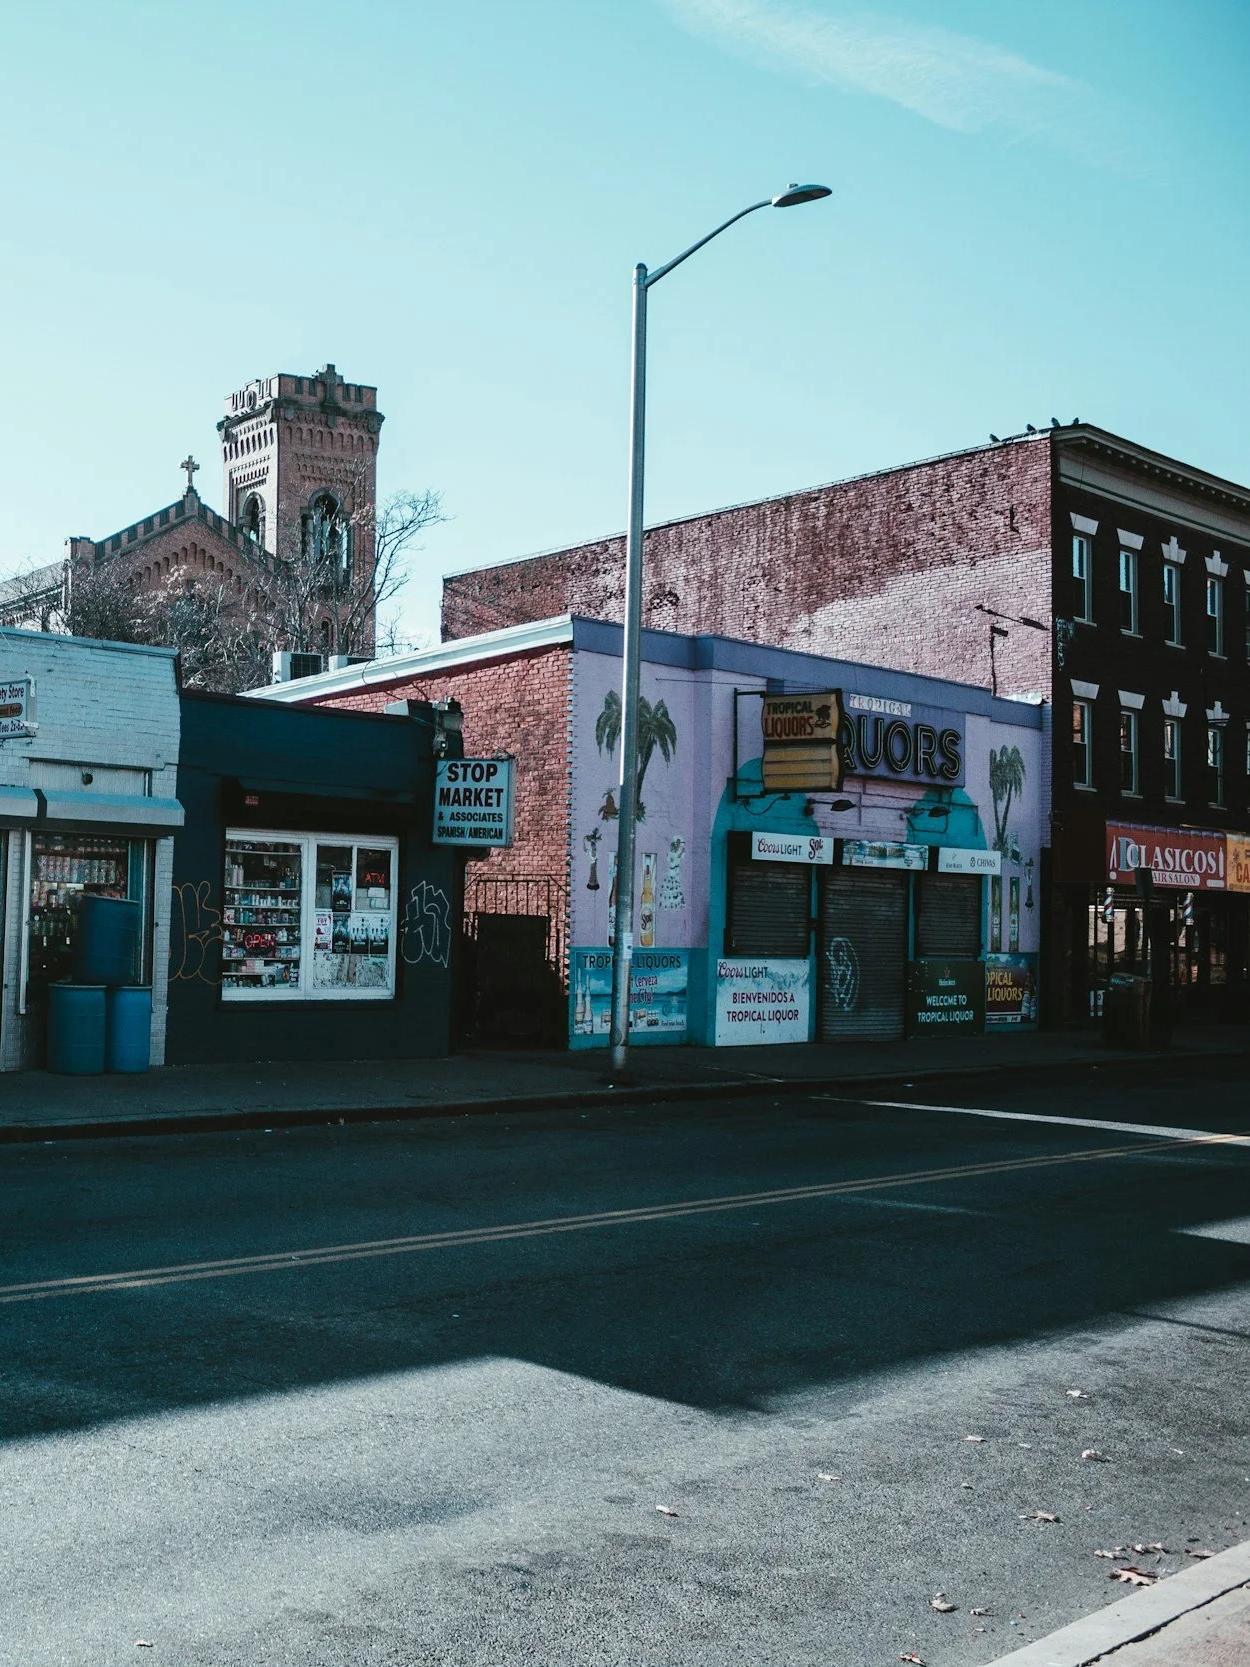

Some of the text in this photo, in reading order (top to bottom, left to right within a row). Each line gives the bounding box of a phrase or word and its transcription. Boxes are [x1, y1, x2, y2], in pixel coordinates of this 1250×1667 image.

[9, 684, 24, 698] Store
[766, 700, 813, 715] TROPICAL
[764, 716, 814, 738] LIQUORS
[842, 712, 962, 780] QUORS
[447, 763, 498, 782] STOP
[439, 787, 504, 807] MARKET
[438, 811, 503, 822] & ASSOCIATES
[437, 825, 503, 840] SPANISH/AMERICAN
[758, 838, 802, 855] Coors LIGHT
[977, 858, 996, 868] CHIVAS
[365, 872, 385, 884] ATM
[1152, 872, 1196, 885] AIR SALON
[244, 933, 276, 949] OPEN
[637, 955, 681, 971] LIQUORS
[718, 961, 768, 978] Coors LIGHT
[986, 972, 1013, 986] OPICAL
[733, 992, 795, 1003] BIENVENIDOS A
[926, 995, 967, 1006] WELCOME TO
[987, 987, 1023, 1002] LIQUORS
[727, 1009, 799, 1023] TROPICAL LIQUOR
[917, 1012, 948, 1023] TROPICAL
[950, 1010, 974, 1023] LIQUOR
